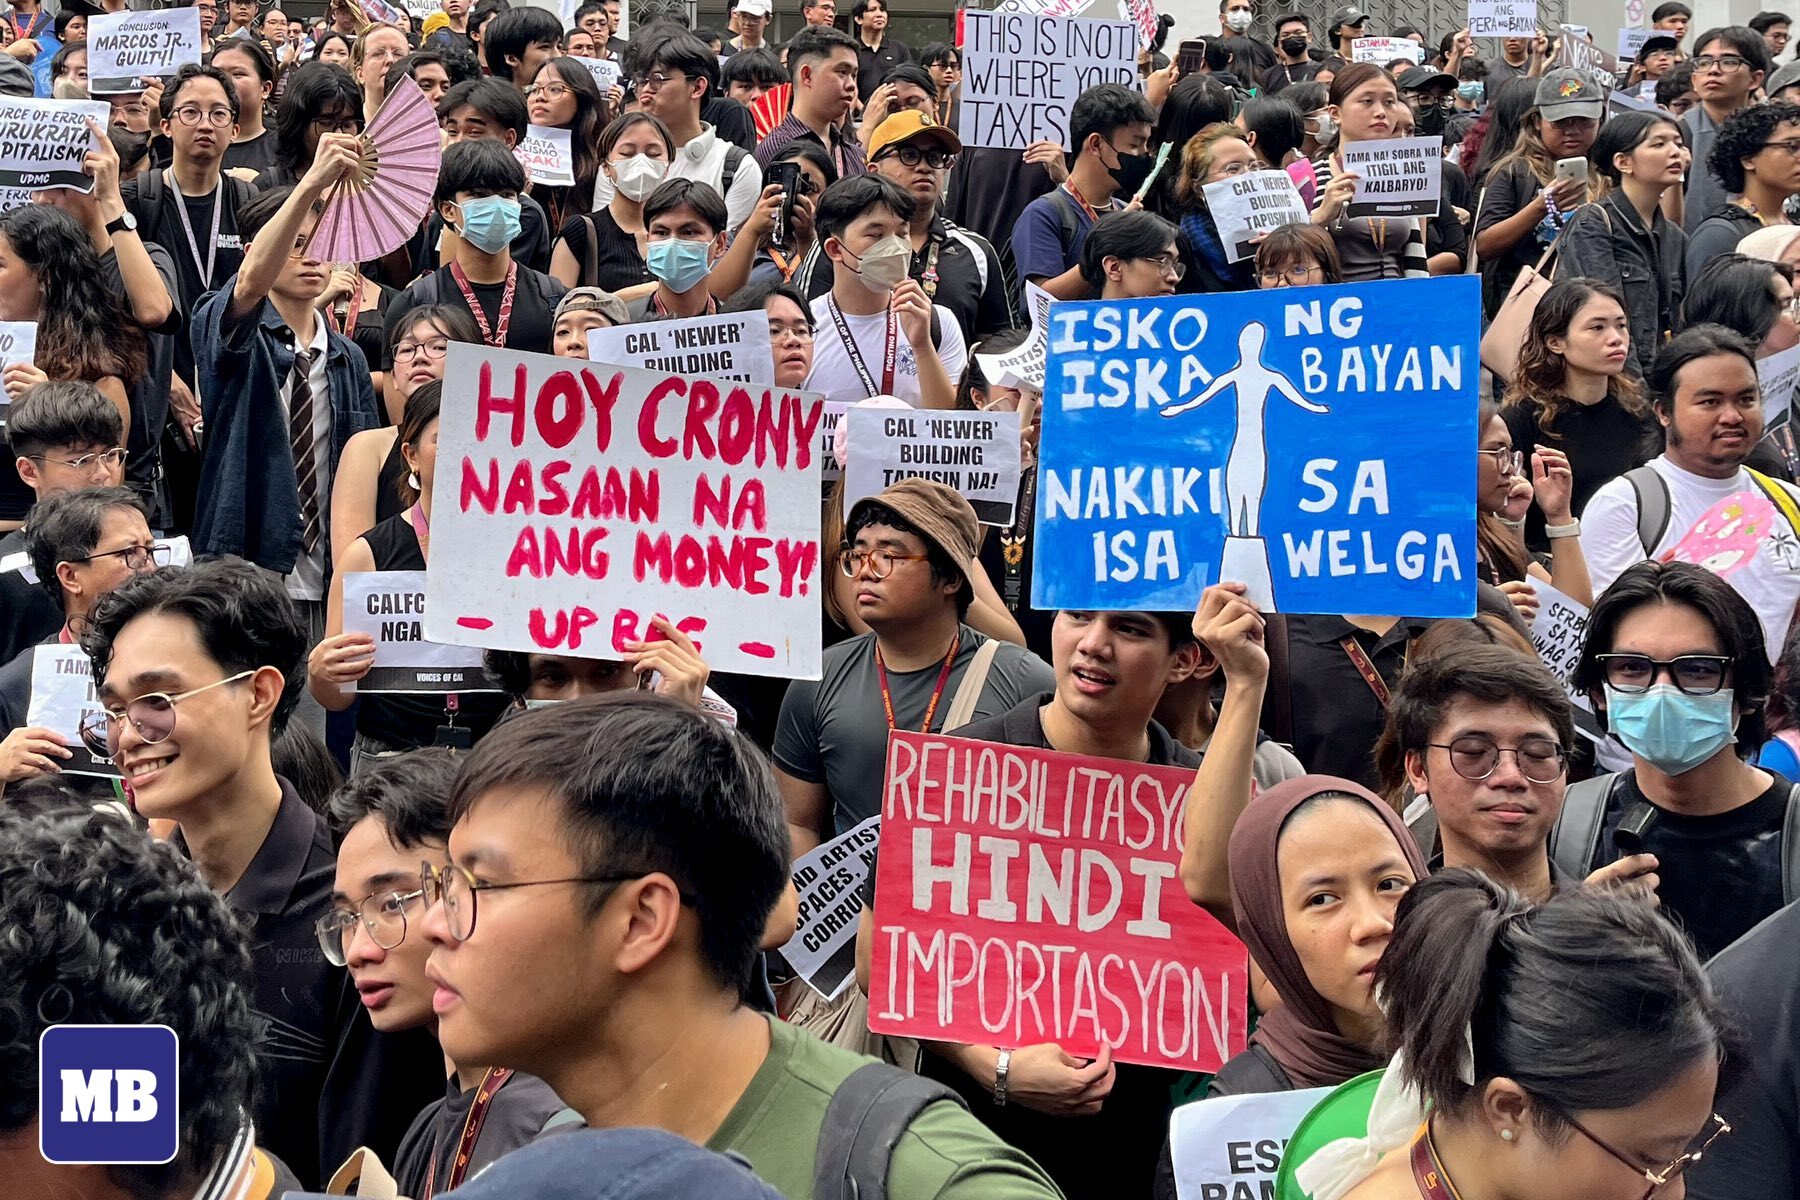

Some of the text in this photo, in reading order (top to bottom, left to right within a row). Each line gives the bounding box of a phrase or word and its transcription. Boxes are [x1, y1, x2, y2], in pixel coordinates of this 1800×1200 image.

[1495, 5, 1514, 16] ANG
[118, 21, 170, 32] CONCLUSION:
[1469, 17, 1497, 32] PERA
[1508, 17, 1537, 32] BAYAN
[95, 33, 158, 51] MARCOS
[967, 14, 1023, 54] THIS
[1033, 17, 1056, 56] IS
[1066, 19, 1136, 61] [NOT]
[116, 47, 174, 67] GUILTY!
[967, 57, 1065, 99] WHERE
[33, 110, 50, 120] OF
[964, 100, 1066, 148] TAXES
[1, 141, 91, 163] PITALISM
[1346, 147, 1440, 163] TAMA NA! SOBRA NA!
[19, 173, 50, 185] UPMC
[1366, 161, 1426, 177] ITIGIL ANG
[1232, 180, 1258, 196] CAL
[1364, 178, 1428, 193] KALBARYO!
[1249, 194, 1292, 211] BUILDING
[1243, 212, 1287, 230] TAPUSIN
[1053, 297, 1363, 355] ISKO NG
[625, 332, 660, 354] CAL
[845, 336, 856, 353] THE
[886, 335, 896, 372] FIGHTING
[1061, 343, 1462, 411] ISKA BAYAN
[475, 360, 823, 471] HOY CRONY
[884, 418, 917, 438] CAL
[900, 444, 983, 466] BUILDING
[967, 472, 999, 490] NA!
[1045, 466, 1223, 520] NAKIKI
[1298, 457, 1390, 516] SA
[459, 455, 767, 533] NASAAN NA
[505, 526, 818, 599] ANG MONEY!
[1093, 528, 1462, 584] ISA WELGA
[381, 621, 422, 642] NGA
[528, 605, 599, 650] UP
[1548, 623, 1566, 645] SA
[416, 673, 464, 682] VOICES OF CAL
[912, 827, 1176, 939] HINDI
[878, 925, 1229, 1064] IMPORTASYON
[1227, 1138, 1289, 1175] ES
